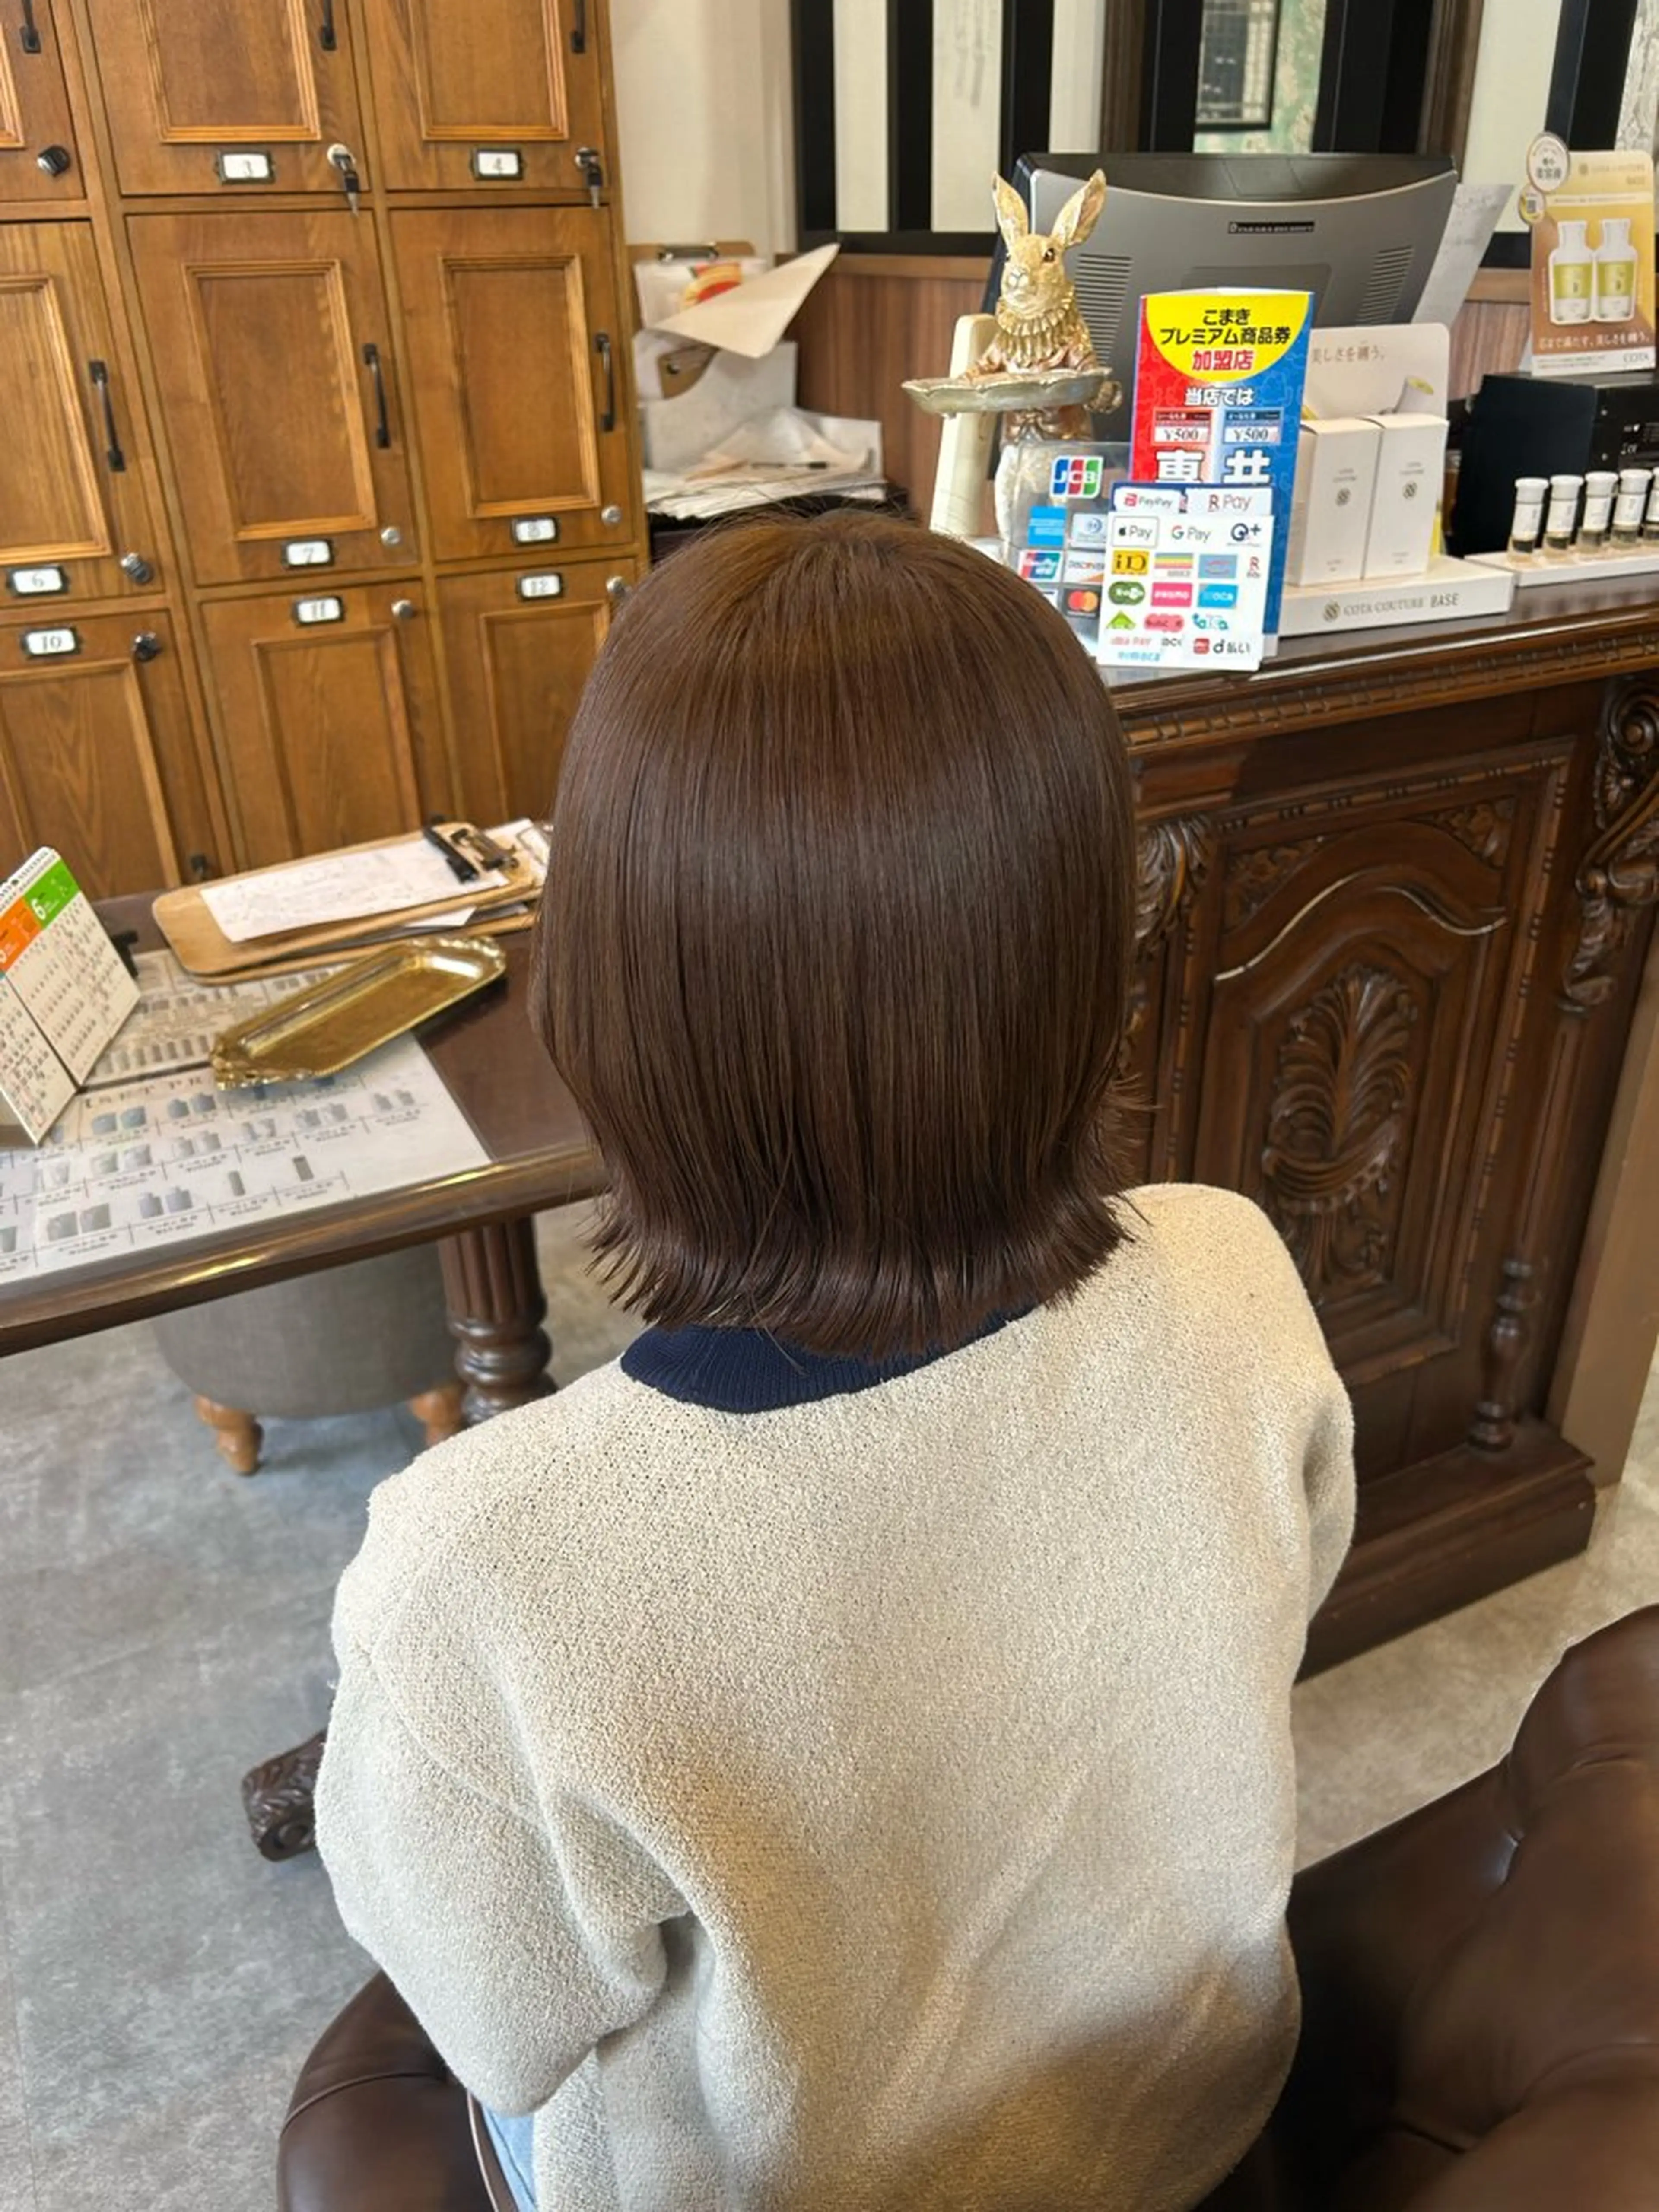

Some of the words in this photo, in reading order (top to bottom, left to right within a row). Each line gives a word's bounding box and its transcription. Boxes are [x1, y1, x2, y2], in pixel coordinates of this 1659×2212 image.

[1203, 308, 1251, 325] こまき
[1160, 327, 1291, 345] プレミアム商品券
[1192, 350, 1253, 371] 加盟店
[1184, 388, 1255, 406] 当店では
[1164, 428, 1199, 441] ¥500
[1234, 428, 1268, 441] ¥500
[1128, 525, 1153, 540] Pay
[1188, 526, 1212, 543] Pay
[302, 547, 315, 563] 7
[31, 573, 44, 588] 6
[40, 635, 62, 650] 10
[31, 898, 47, 920] 6
